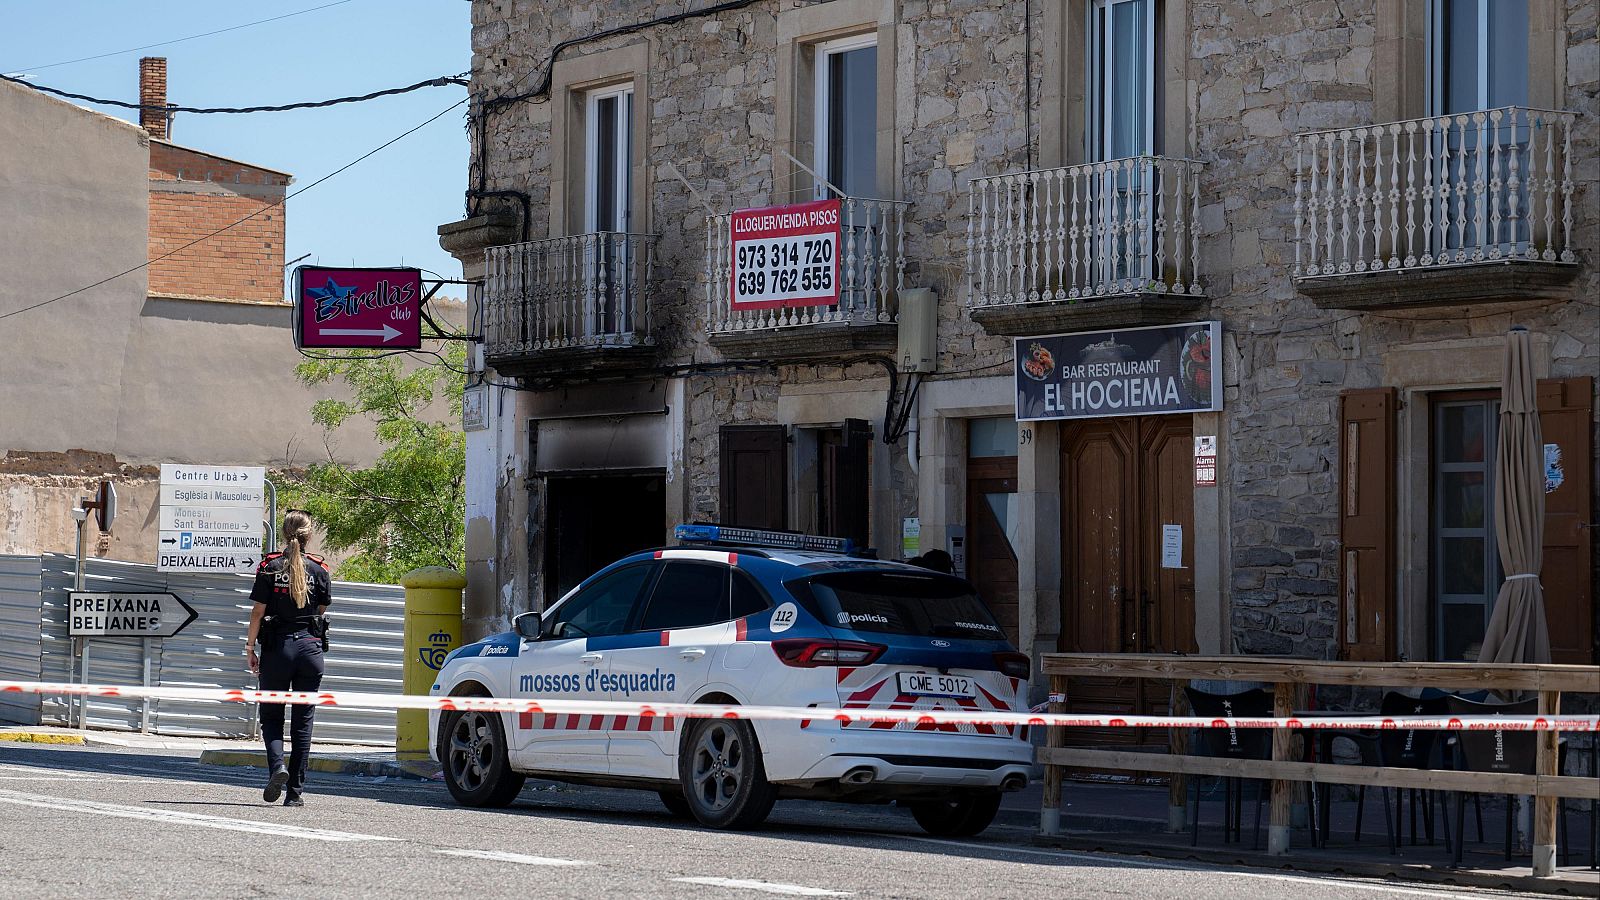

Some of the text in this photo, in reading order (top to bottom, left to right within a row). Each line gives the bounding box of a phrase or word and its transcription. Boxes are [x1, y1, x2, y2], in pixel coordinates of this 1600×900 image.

[735, 209, 837, 233] LLOGUER/VENDA PISOS
[739, 239, 832, 269] 973 314 720
[739, 266, 831, 295] 639 762 555
[314, 280, 415, 323] Estrellas
[390, 306, 411, 320] club
[1062, 359, 1161, 379] BAR RESTAURANT
[1044, 376, 1180, 411] EL HOCIEMA
[1020, 429, 1032, 445] 39
[175, 470, 238, 481] Centre Urbà
[214, 491, 251, 501] Mausoleu
[174, 508, 211, 518] Monestir
[174, 519, 240, 530] Sant Bartomeu
[192, 536, 231, 547] APARCAMENT
[231, 537, 261, 548] MUNICIPAL
[161, 555, 236, 568] DEIXALLERIA
[73, 598, 161, 612] PREIXANA
[775, 611, 793, 621] 112
[851, 613, 888, 623] policia
[73, 616, 160, 631] BELIANES
[519, 668, 676, 697] mossos d'esquadra
[909, 676, 968, 694] CME 5012
